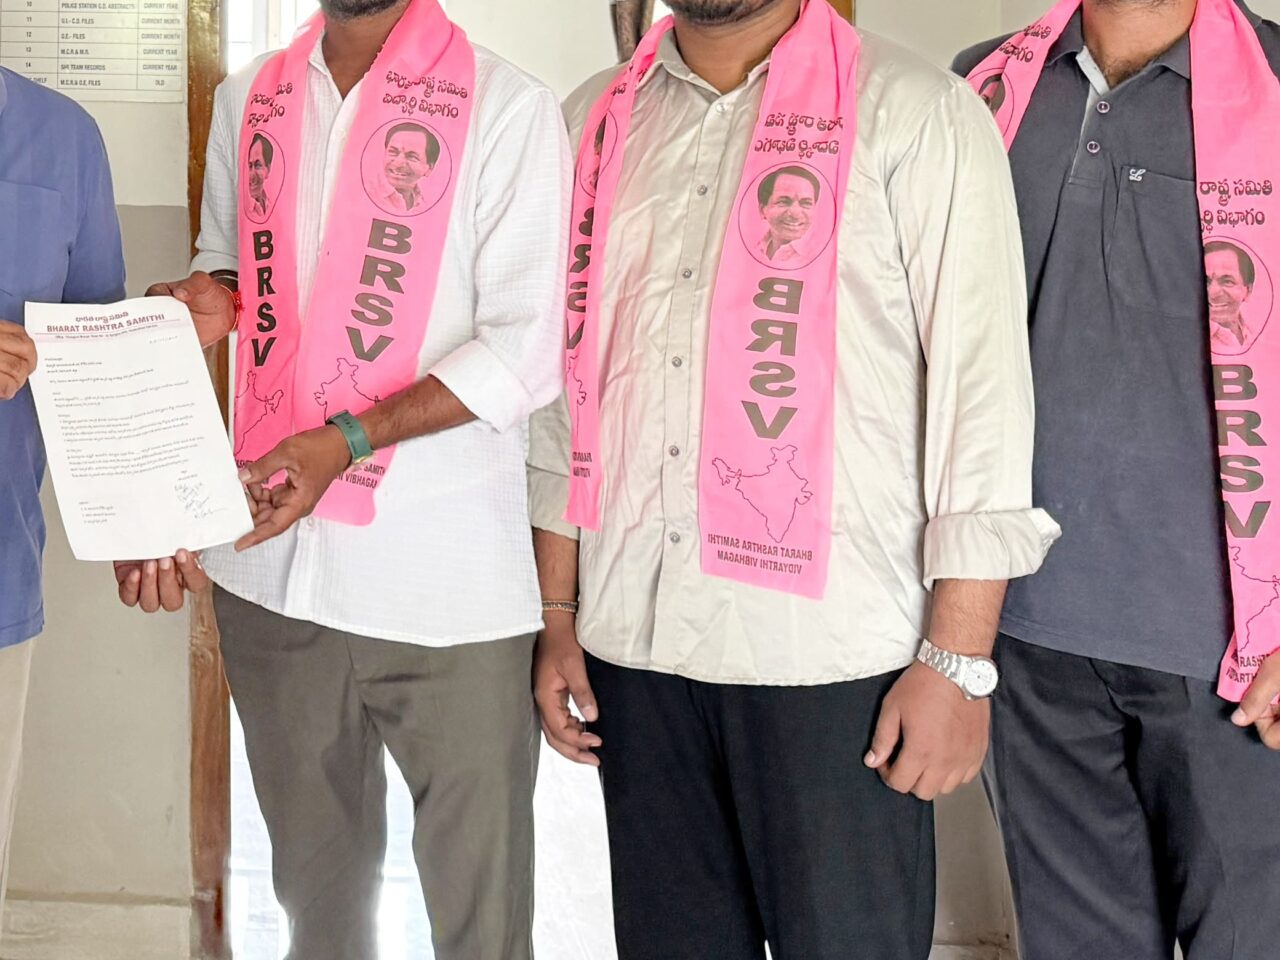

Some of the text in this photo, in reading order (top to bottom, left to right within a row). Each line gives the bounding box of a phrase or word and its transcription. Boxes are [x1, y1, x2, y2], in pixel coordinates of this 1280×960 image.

[419, 99, 459, 118] విభాగం
[1200, 179, 1272, 207] రాష్ట్ర సమితి
[1217, 208, 1265, 228] విభాగం
[251, 229, 277, 368] BRSV
[345, 218, 413, 362] BRSV
[47, 325, 80, 333] BHARAT
[82, 322, 124, 332] RASHTRA
[126, 314, 165, 326] SAMITHI
[1213, 364, 1271, 538] BRSV
